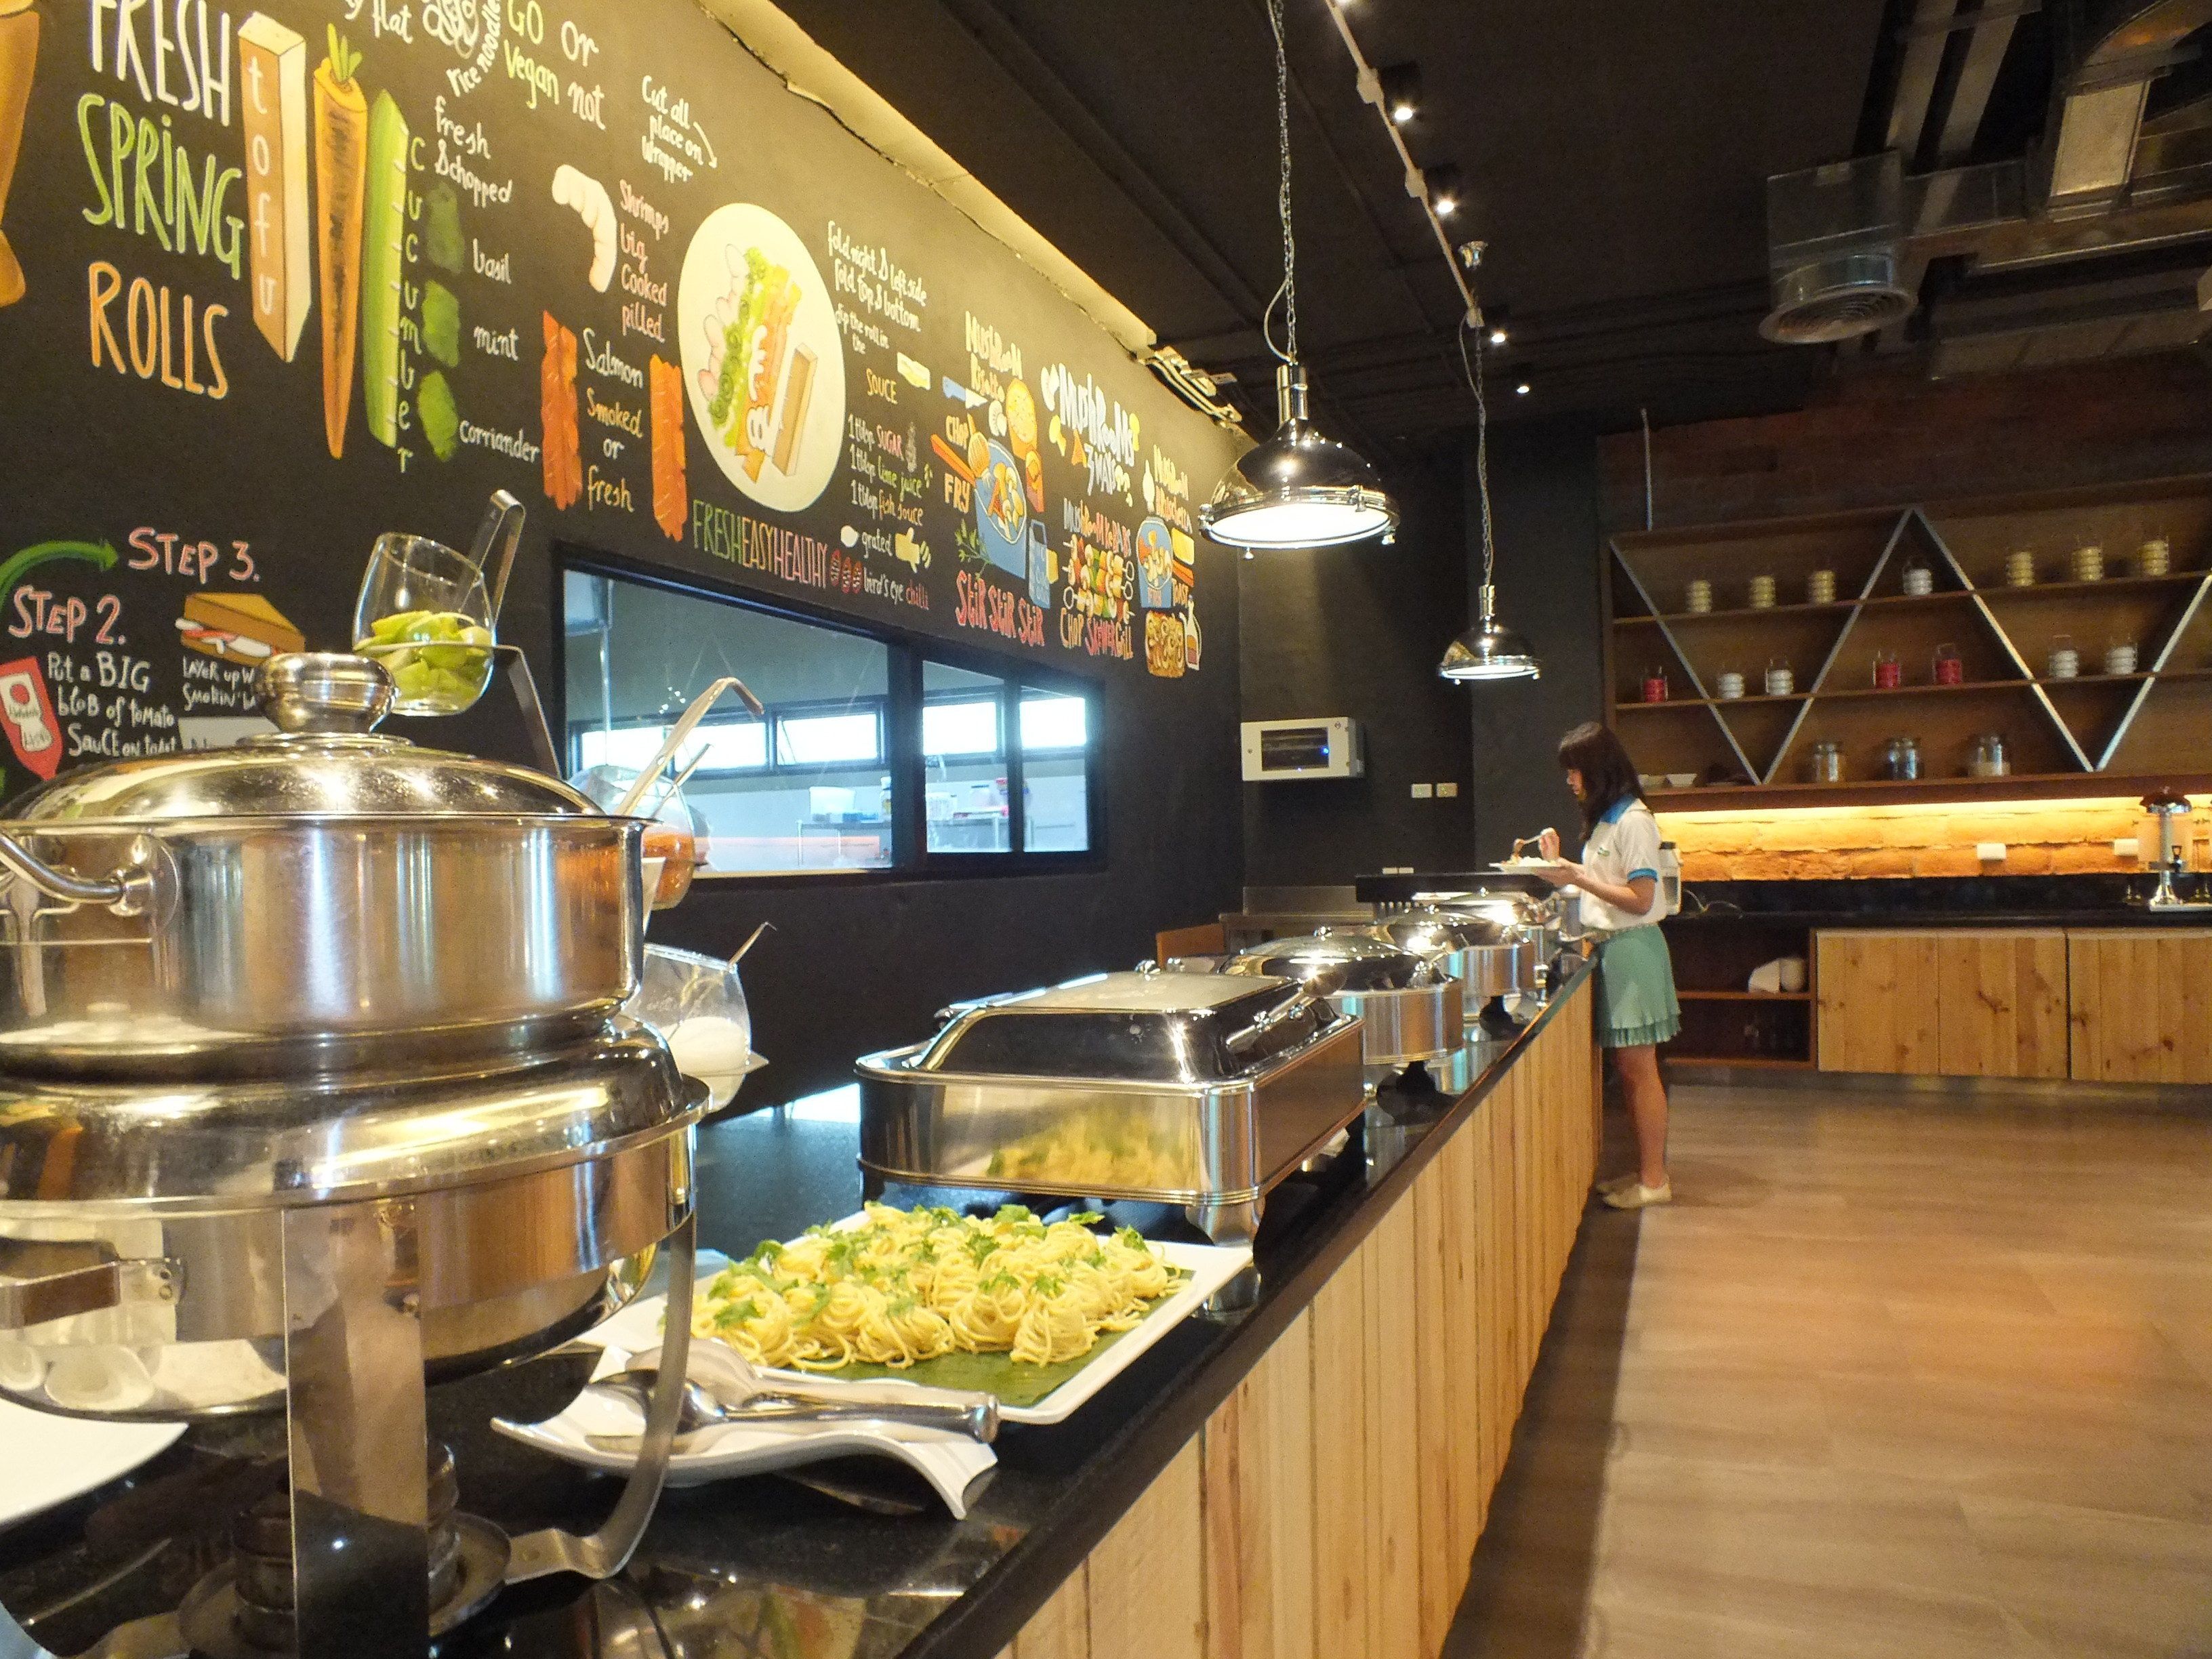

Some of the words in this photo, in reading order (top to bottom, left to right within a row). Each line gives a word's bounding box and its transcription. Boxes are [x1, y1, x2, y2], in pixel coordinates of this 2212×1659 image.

[508, 0, 543, 44] GO
[91, 0, 230, 127] FRESH
[446, 66, 482, 97] rice
[504, 39, 560, 109] Vegan
[642, 75, 668, 115] Cut
[671, 98, 690, 129] all
[434, 95, 491, 160] fresh
[684, 140, 703, 165] on
[621, 264, 668, 307] Cooked
[89, 261, 228, 399] ROLLS
[474, 325, 518, 361] mint
[583, 327, 644, 389] Salmon
[603, 438, 624, 459] or
[588, 464, 634, 513] fresh
[944, 472, 970, 514] FRY
[128, 527, 219, 583] STEP
[861, 528, 893, 559] grated
[8, 585, 87, 643] STEP
[96, 651, 151, 693] BIG
[106, 696, 126, 728] of
